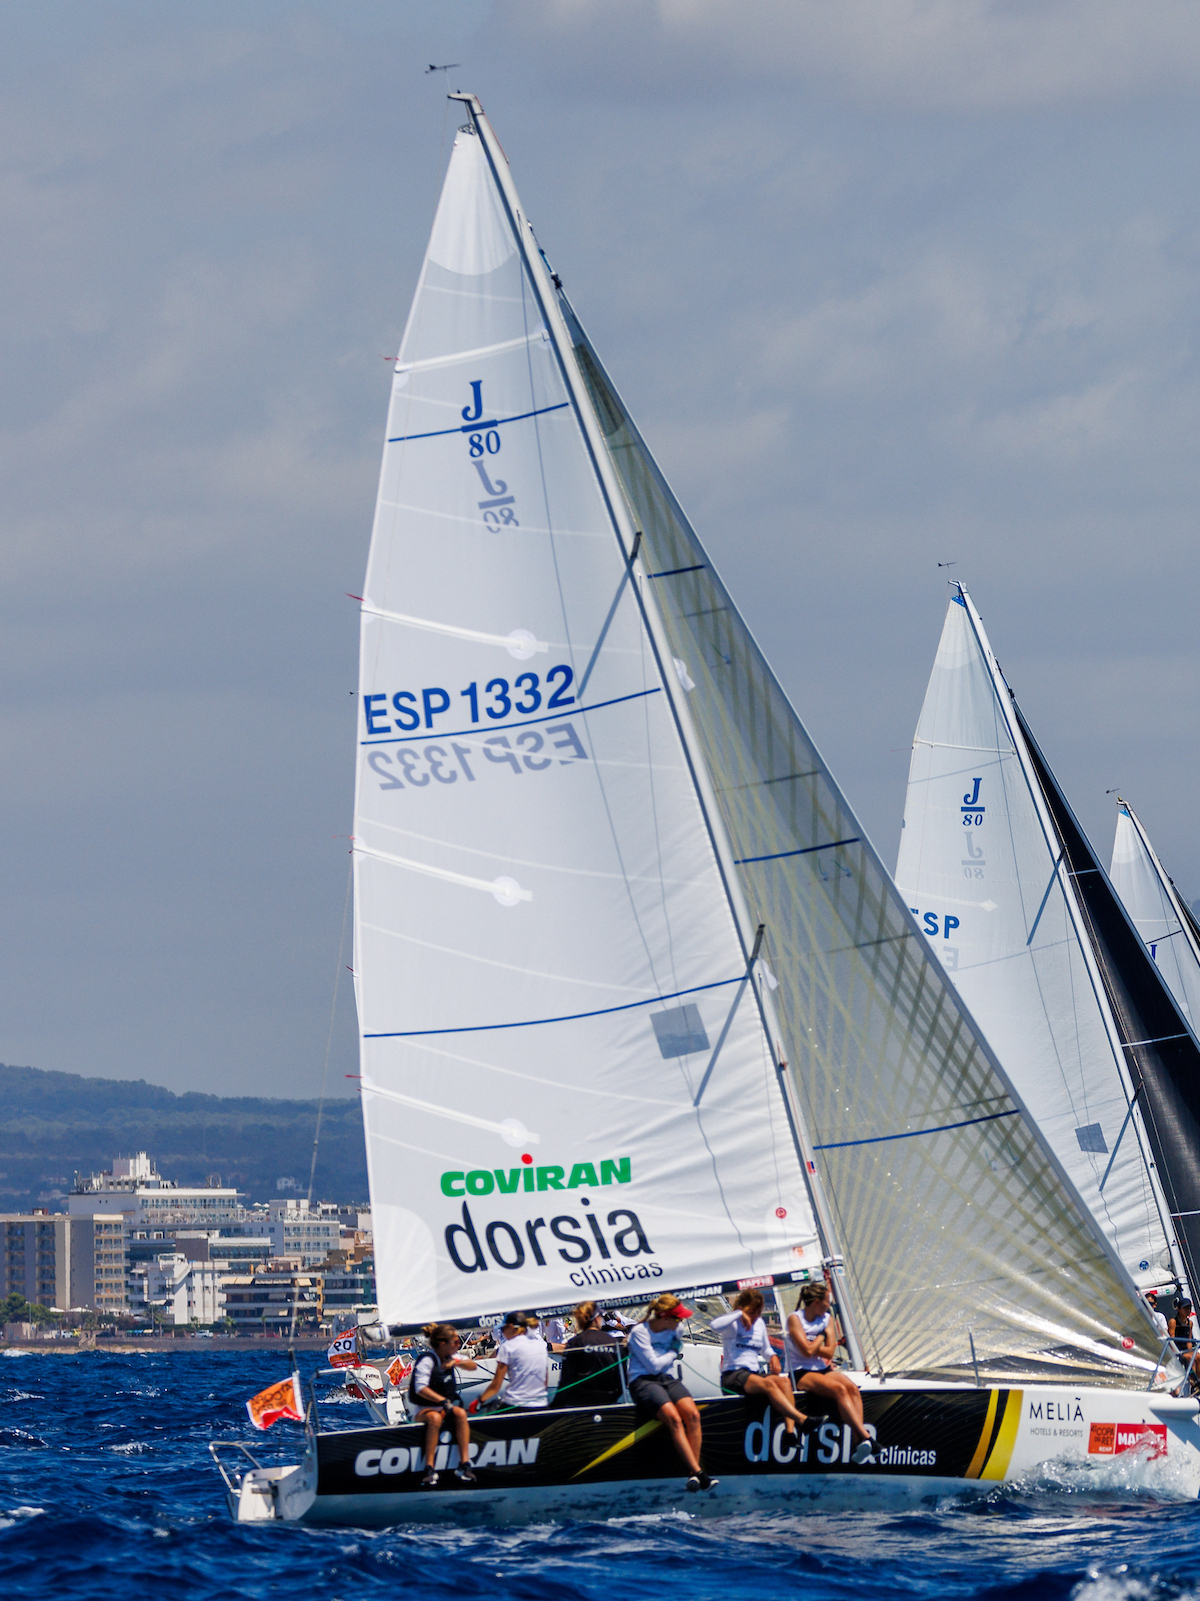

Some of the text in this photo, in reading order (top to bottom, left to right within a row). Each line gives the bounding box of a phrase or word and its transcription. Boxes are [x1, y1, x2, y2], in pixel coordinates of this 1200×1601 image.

[461, 380, 483, 421] J
[468, 430, 501, 458] 80
[364, 664, 575, 734] ESP 1332
[963, 777, 982, 805] J
[962, 814, 983, 827] 80
[909, 908, 960, 939] SP
[445, 1198, 654, 1273] dorsia
[570, 1262, 663, 1286] clínicas
[739, 1277, 771, 1289] MAPFRE
[1030, 1428, 1083, 1438] HOTELS & RESORTS
[880, 1446, 937, 1465] clínicas
